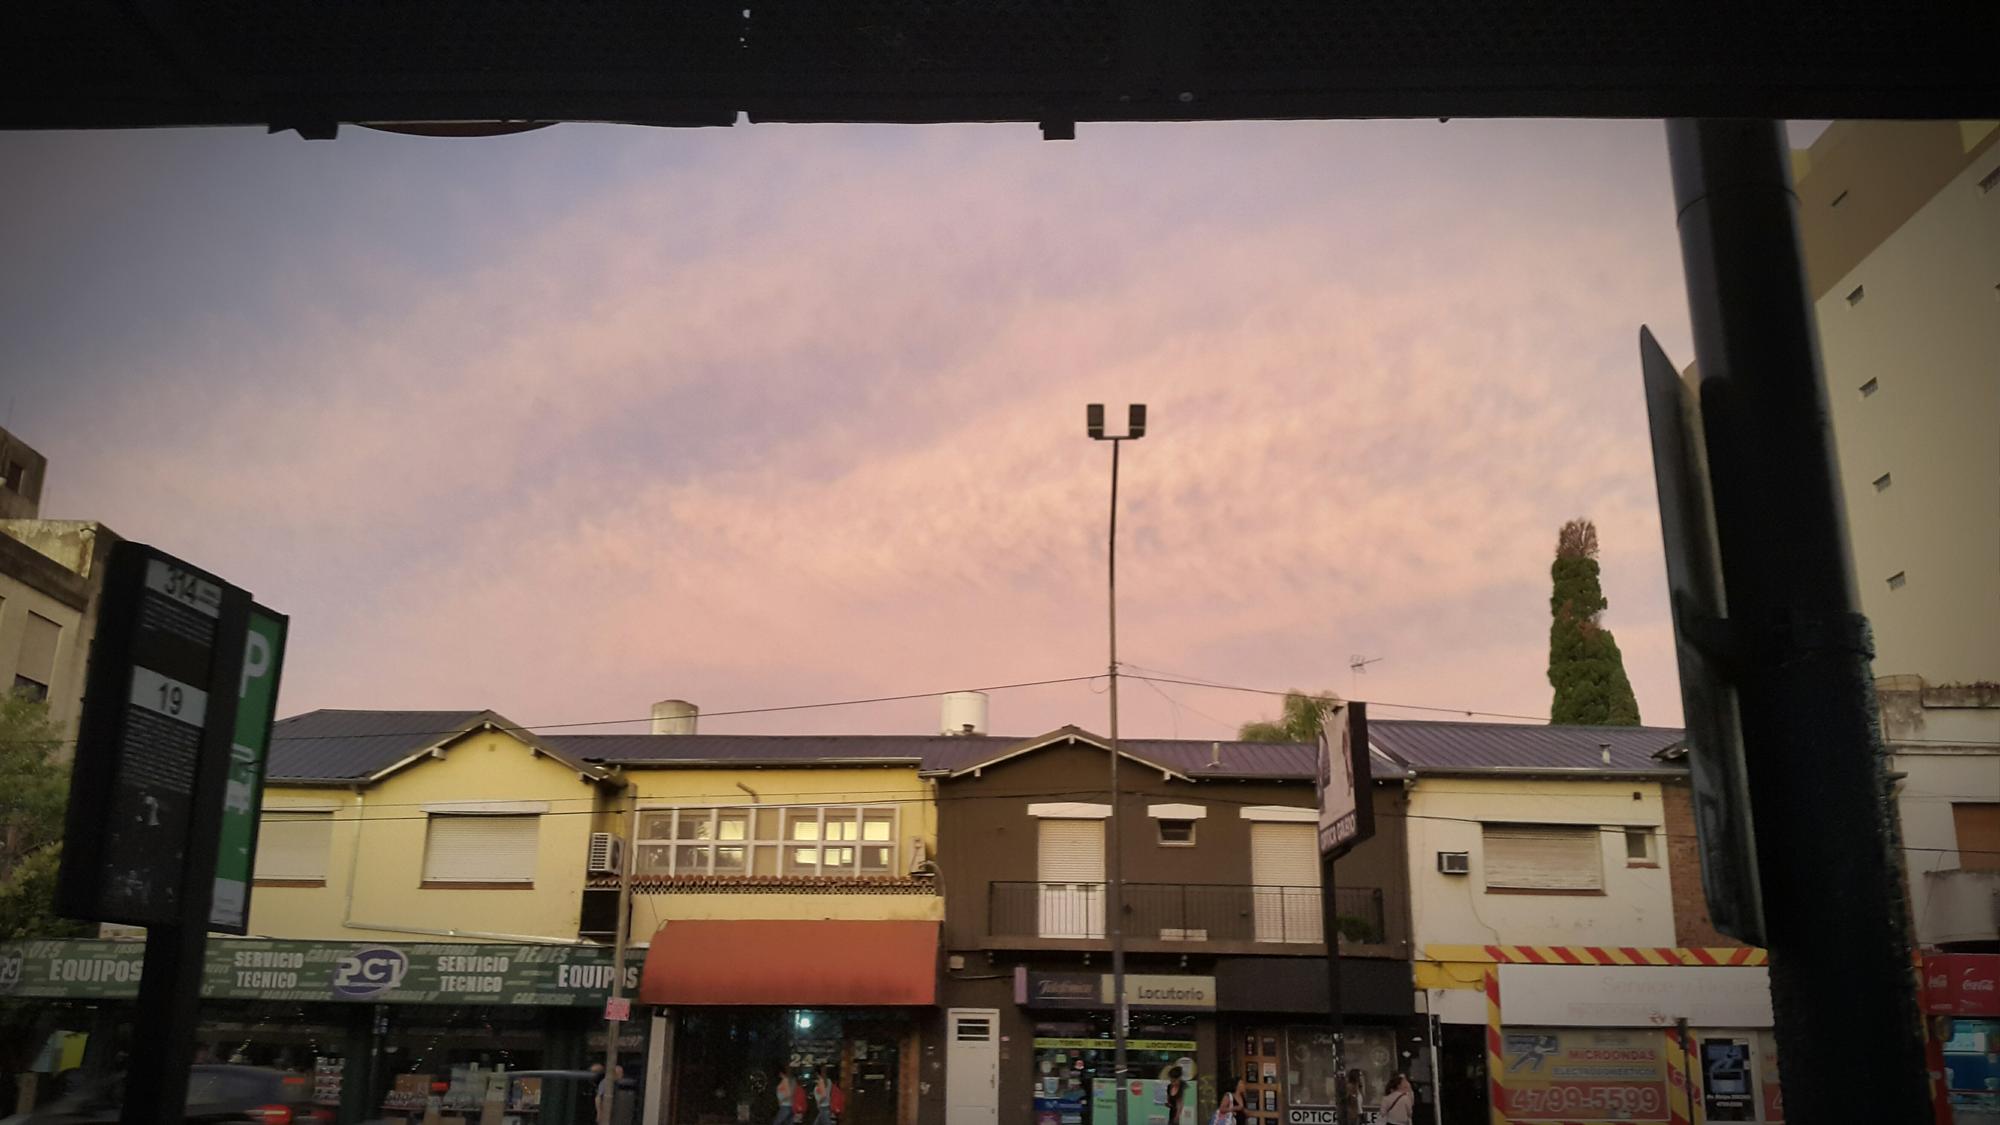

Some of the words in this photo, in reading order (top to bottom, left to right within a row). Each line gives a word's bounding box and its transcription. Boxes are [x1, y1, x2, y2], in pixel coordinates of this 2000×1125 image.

[165, 564, 198, 604] 314
[240, 630, 271, 698] P
[159, 682, 183, 715] 19
[234, 951, 305, 968] SERVICIO
[437, 956, 509, 973] SERVICIO
[49, 959, 144, 982] EQUIPOS
[236, 971, 298, 988] TECNICO
[558, 964, 639, 989] EQUIPS
[440, 975, 503, 992] TECNICO
[1138, 985, 1205, 1001] Locutorio
[1567, 1048, 1657, 1061] MICROONDAS
[1511, 1086, 1661, 1114] 4799-5599
